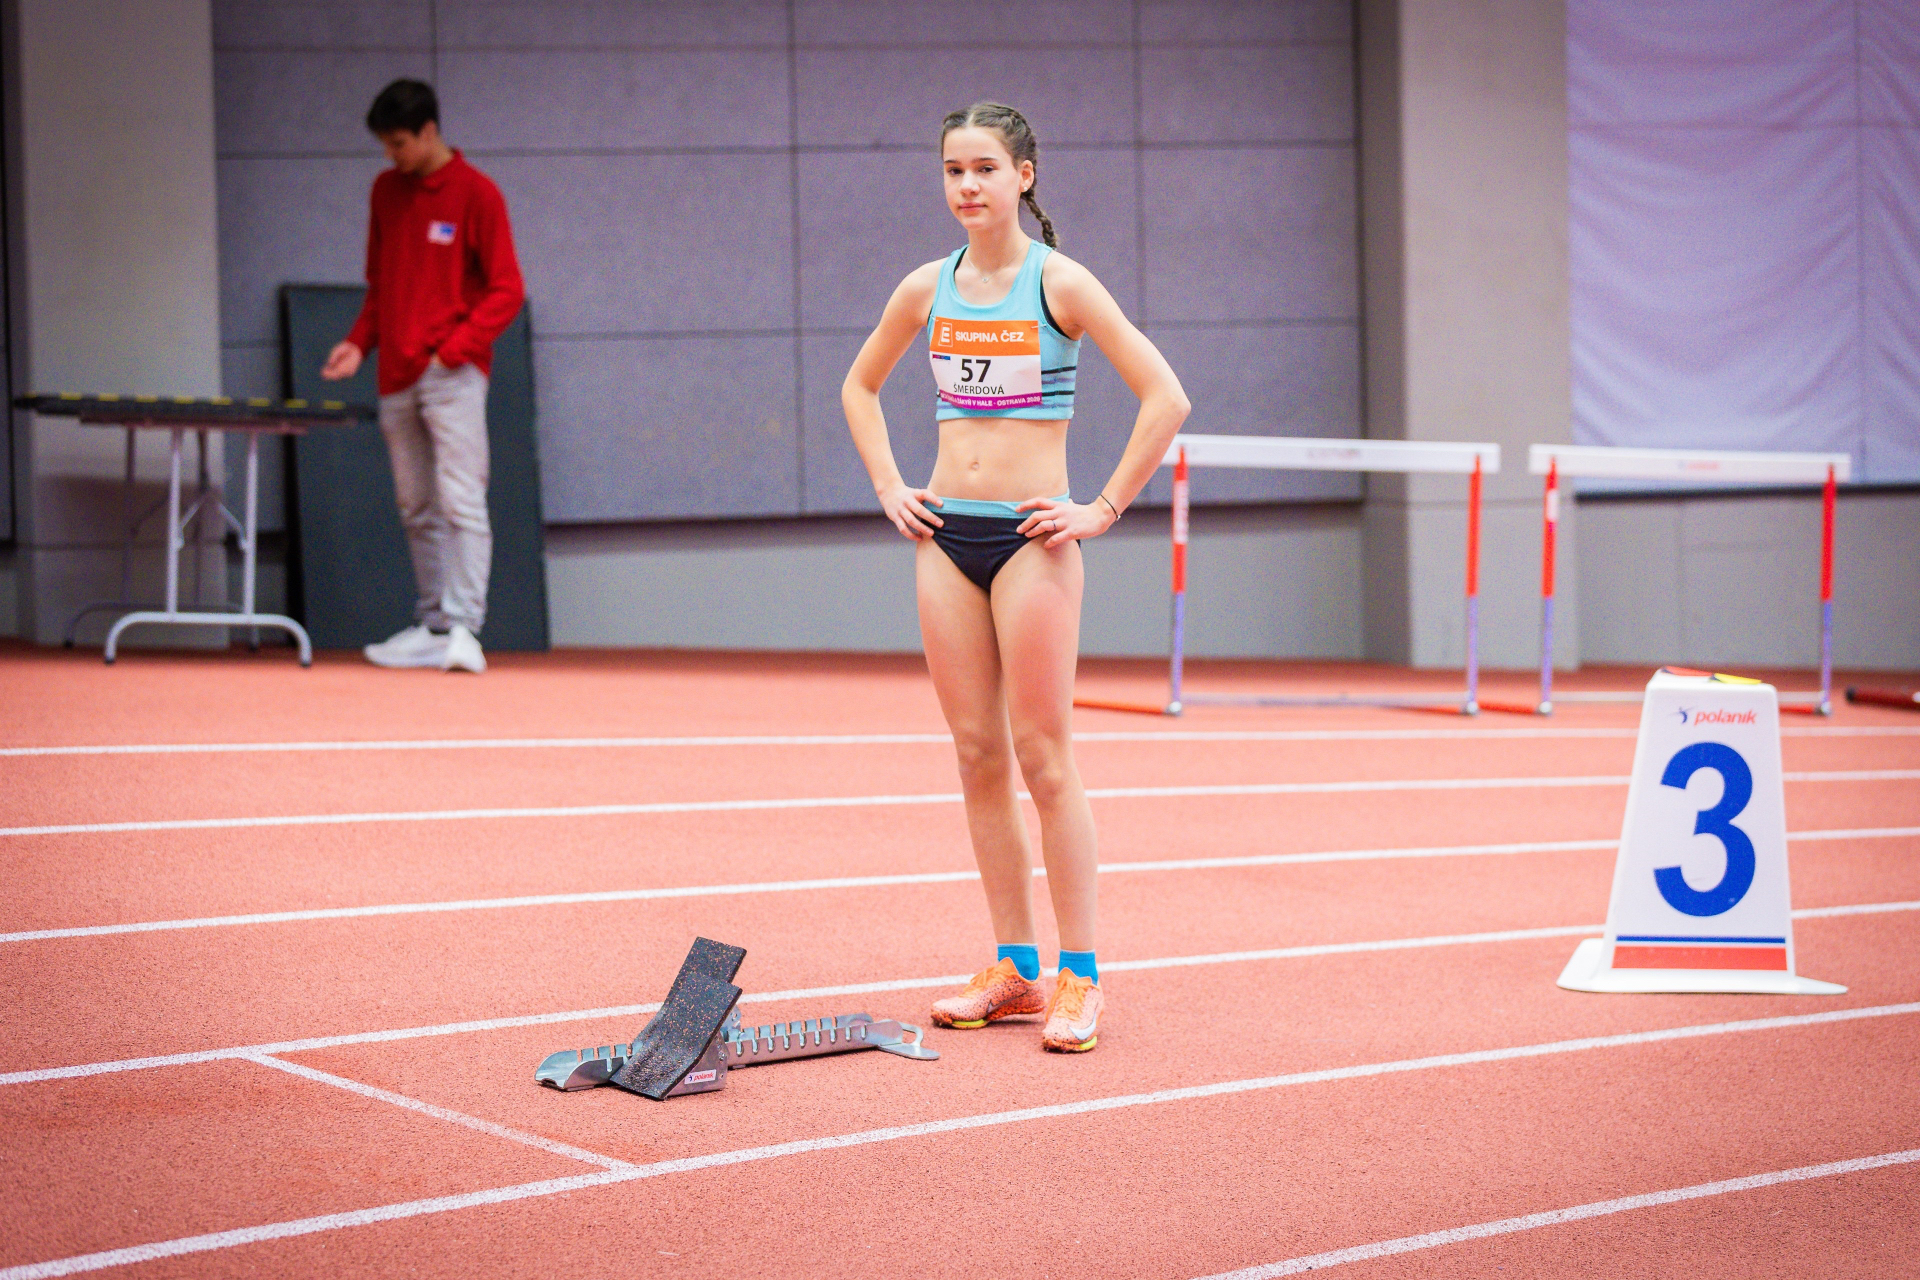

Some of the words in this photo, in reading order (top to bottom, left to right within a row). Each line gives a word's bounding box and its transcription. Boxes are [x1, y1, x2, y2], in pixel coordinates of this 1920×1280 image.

[955, 331, 999, 343] SKUPINA
[1000, 330, 1024, 342] ČEZ
[961, 358, 991, 383] 57
[953, 383, 1005, 395] ŠMERDOVÁ
[977, 399, 993, 407] HALE
[997, 397, 1026, 406] OSTRAVA
[1694, 708, 1757, 726] polanik
[1653, 741, 1756, 917] 3
